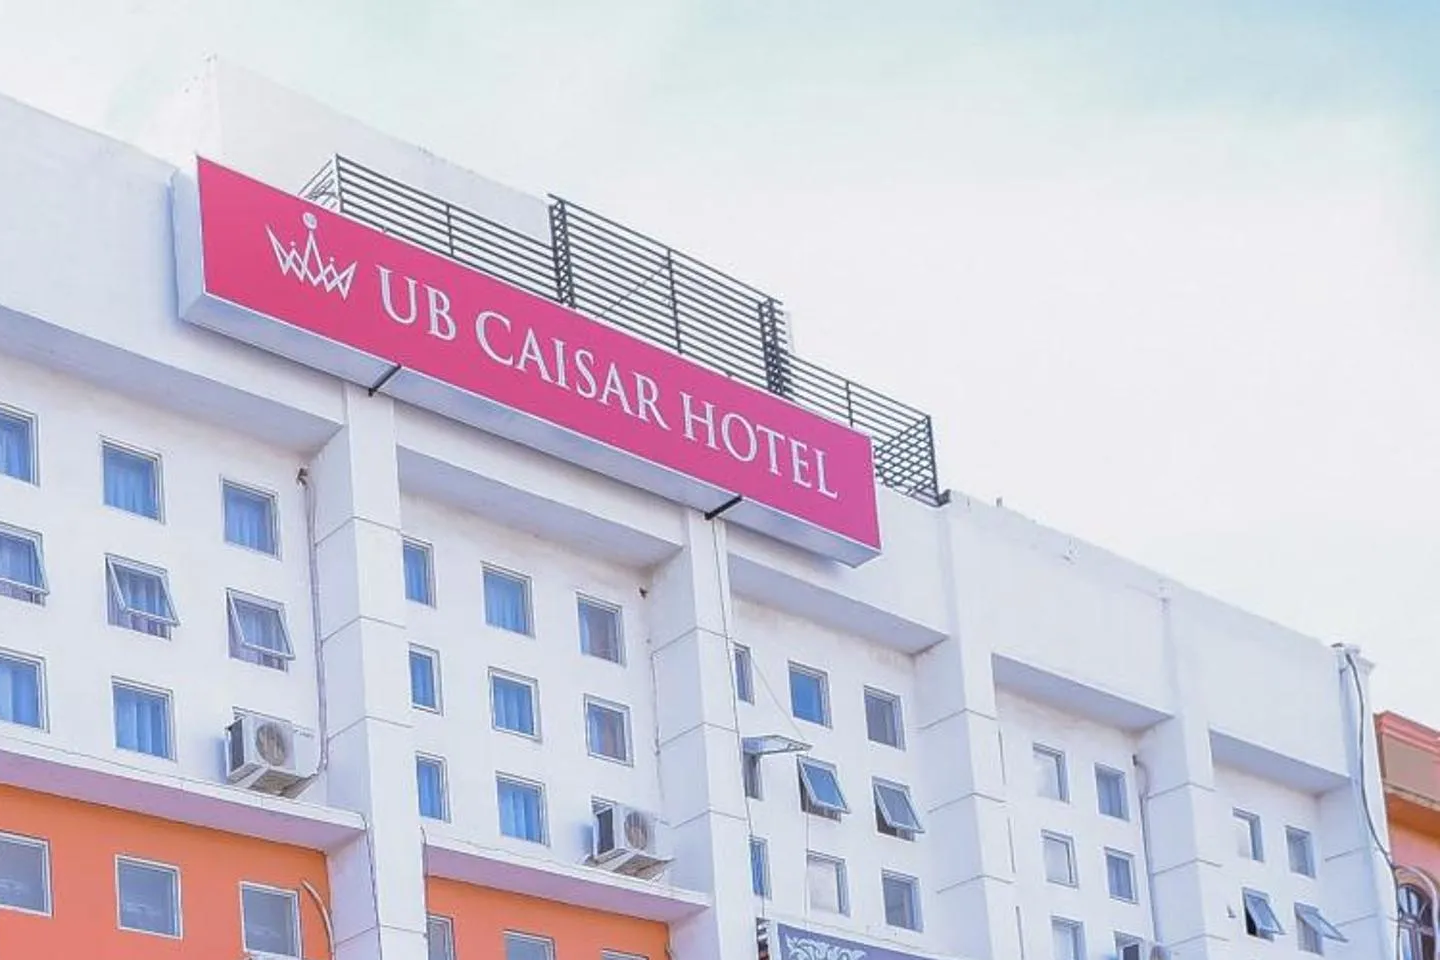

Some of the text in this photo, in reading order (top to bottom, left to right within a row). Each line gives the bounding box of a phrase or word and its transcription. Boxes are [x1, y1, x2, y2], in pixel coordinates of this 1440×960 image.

[376, 264, 839, 499] UB CAISAR HOTEL
